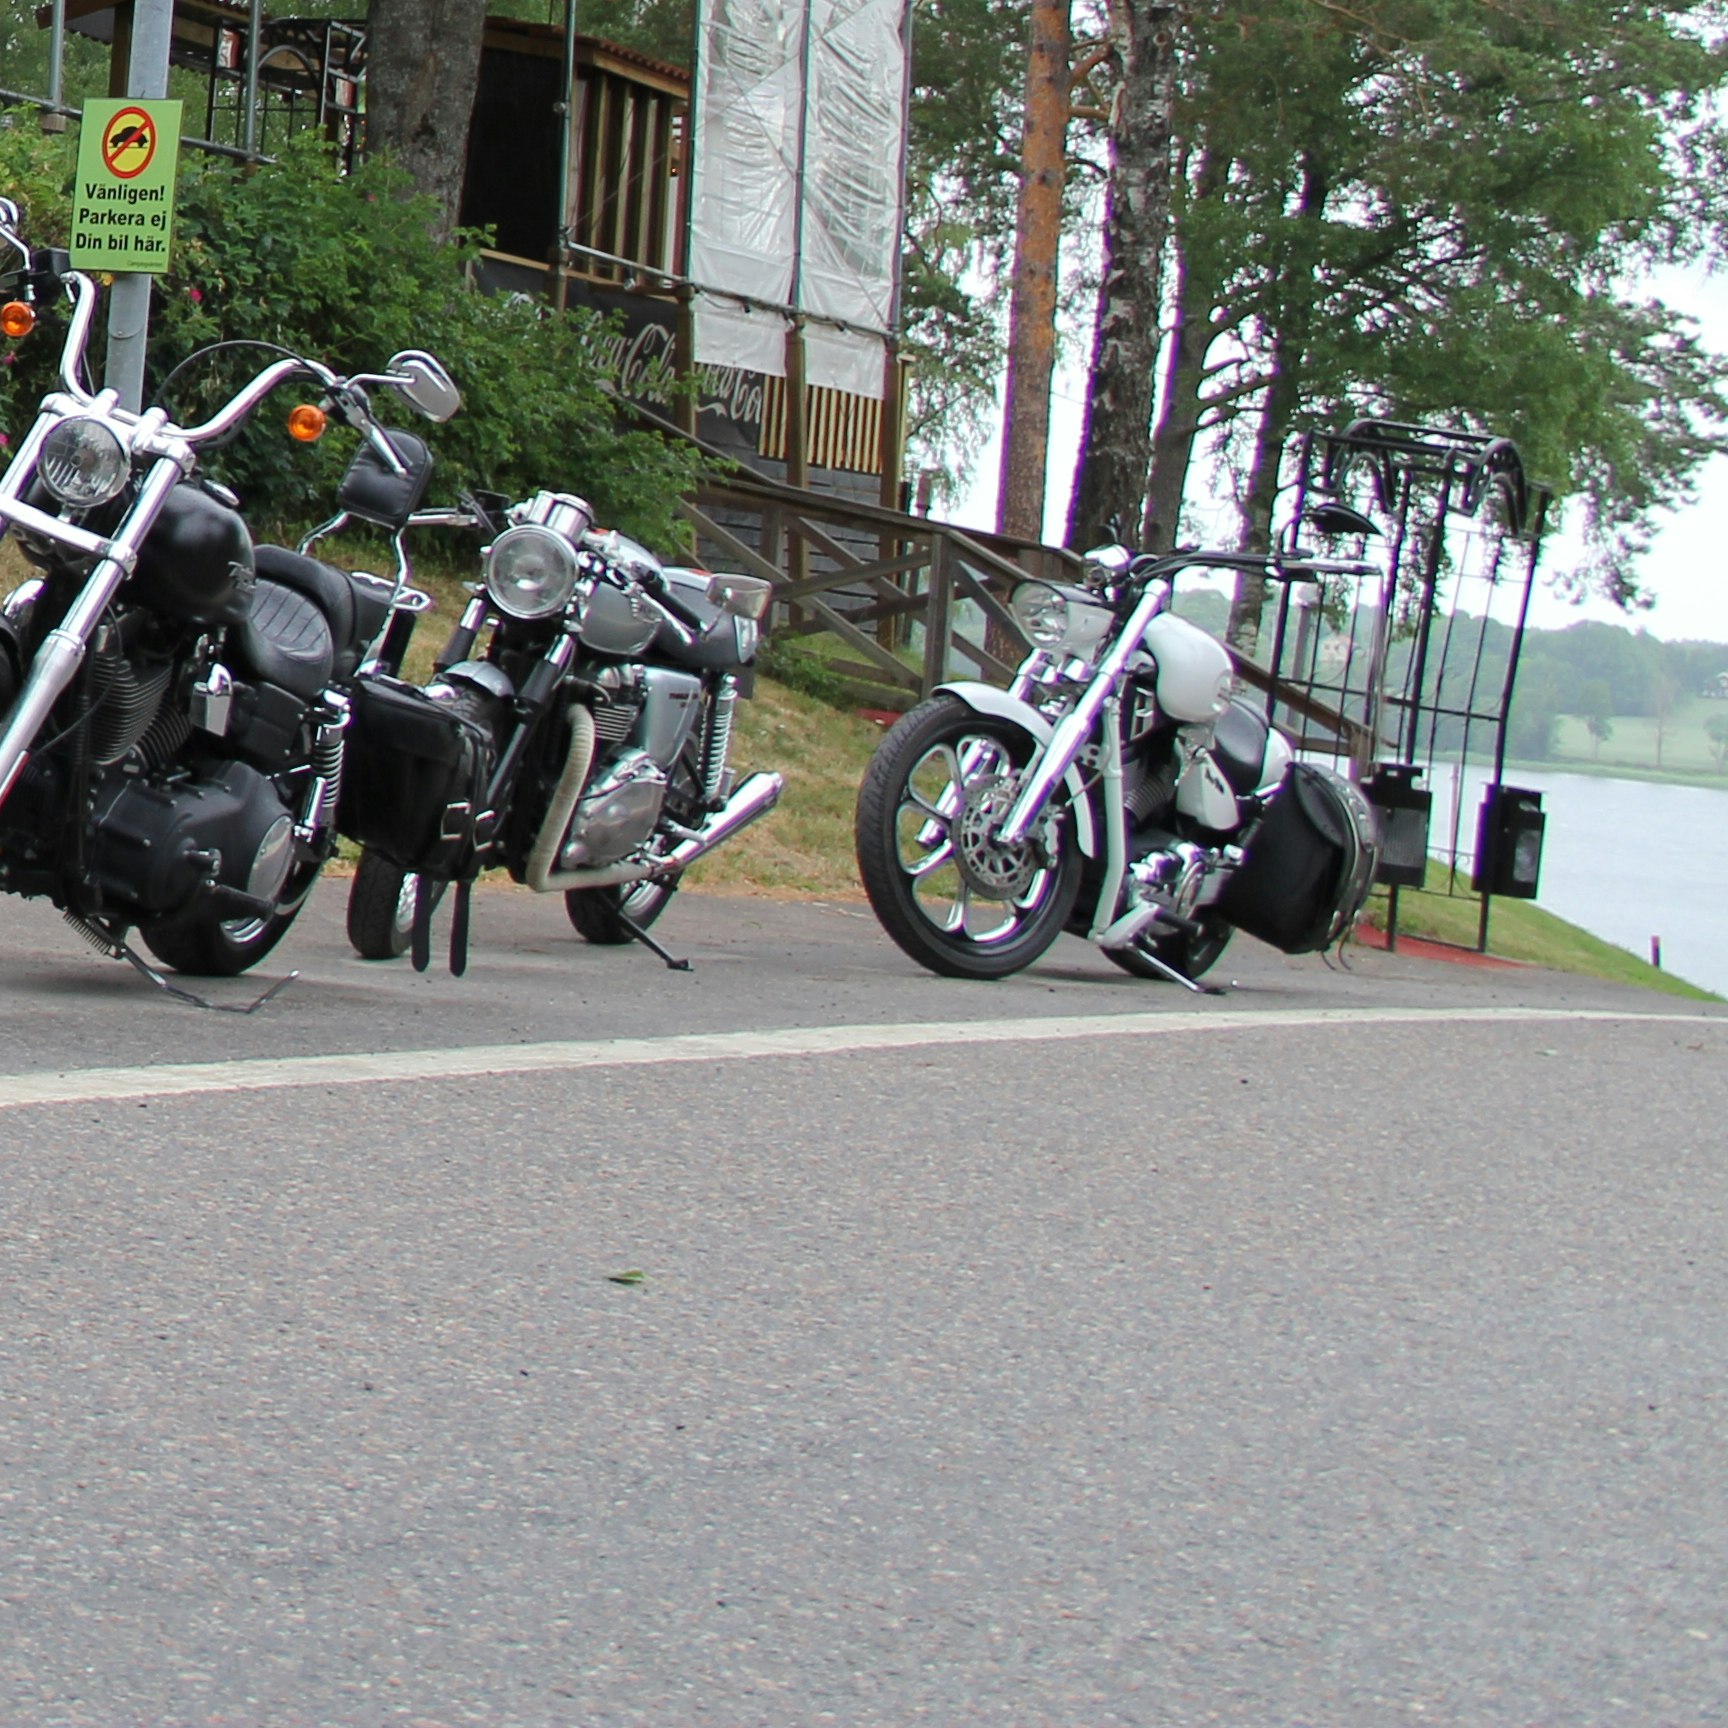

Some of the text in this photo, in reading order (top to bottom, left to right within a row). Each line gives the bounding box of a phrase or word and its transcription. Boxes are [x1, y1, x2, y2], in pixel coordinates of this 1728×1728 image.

[85, 183, 165, 205] Vänligen!
[78, 208, 167, 230] Parkera ej
[75, 233, 166, 252] Din bil här.
